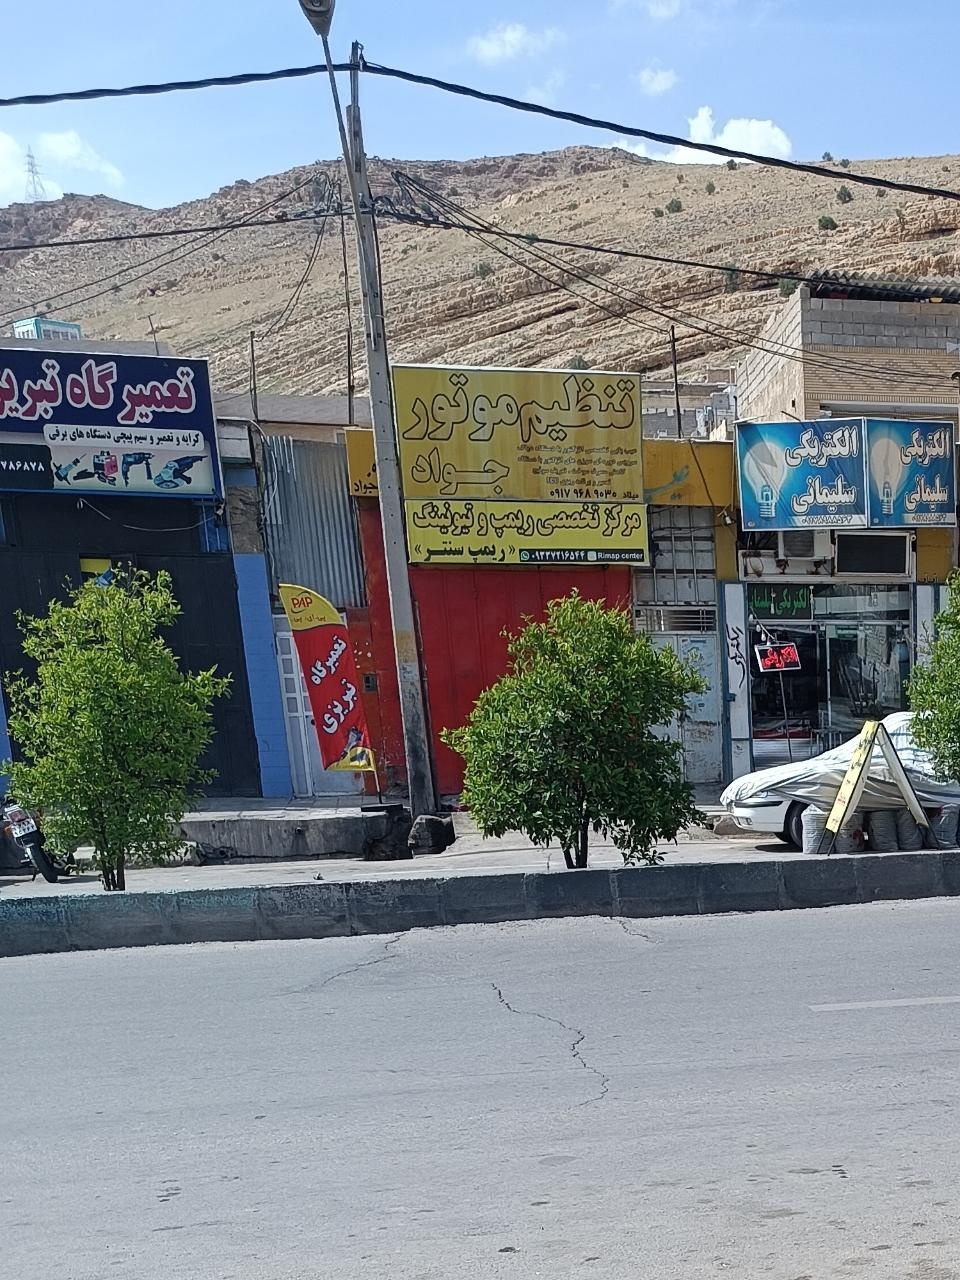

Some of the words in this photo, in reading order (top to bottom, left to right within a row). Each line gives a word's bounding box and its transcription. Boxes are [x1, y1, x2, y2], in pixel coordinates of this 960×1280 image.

[402, 373, 519, 441] موتور
[519, 374, 635, 442] تنظیم
[48, 425, 68, 441] برقی
[69, 426, 85, 441] های
[86, 428, 111, 440] دستگاه
[113, 431, 132, 444] پیچی
[134, 434, 147, 444] سیم
[156, 432, 174, 445] تعمیر
[181, 432, 200, 446] کرایه
[176, 436, 180, 446] و
[785, 426, 859, 467] الکتریکی
[900, 428, 950, 467] الکتریکی
[411, 447, 510, 495] جواد
[354, 480, 378, 494] جواد
[550, 489, 570, 498] ۰۹۱۷
[574, 489, 591, 498] ۹۶۸
[594, 489, 617, 498] ۹۰۳۰
[791, 474, 857, 514] سلیمانی
[904, 474, 949, 512] سلیمانی
[623, 491, 639, 500] میلاد
[412, 502, 474, 535] تیونینگ
[477, 512, 489, 536] و
[490, 510, 534, 538] ریمپ
[536, 503, 600, 537] تخصصی
[603, 503, 642, 537] مرکز
[598, 552, 619, 560] Rimap
[621, 552, 643, 560] center
[291, 596, 312, 608] PAP
[322, 677, 357, 734] تبریزی
